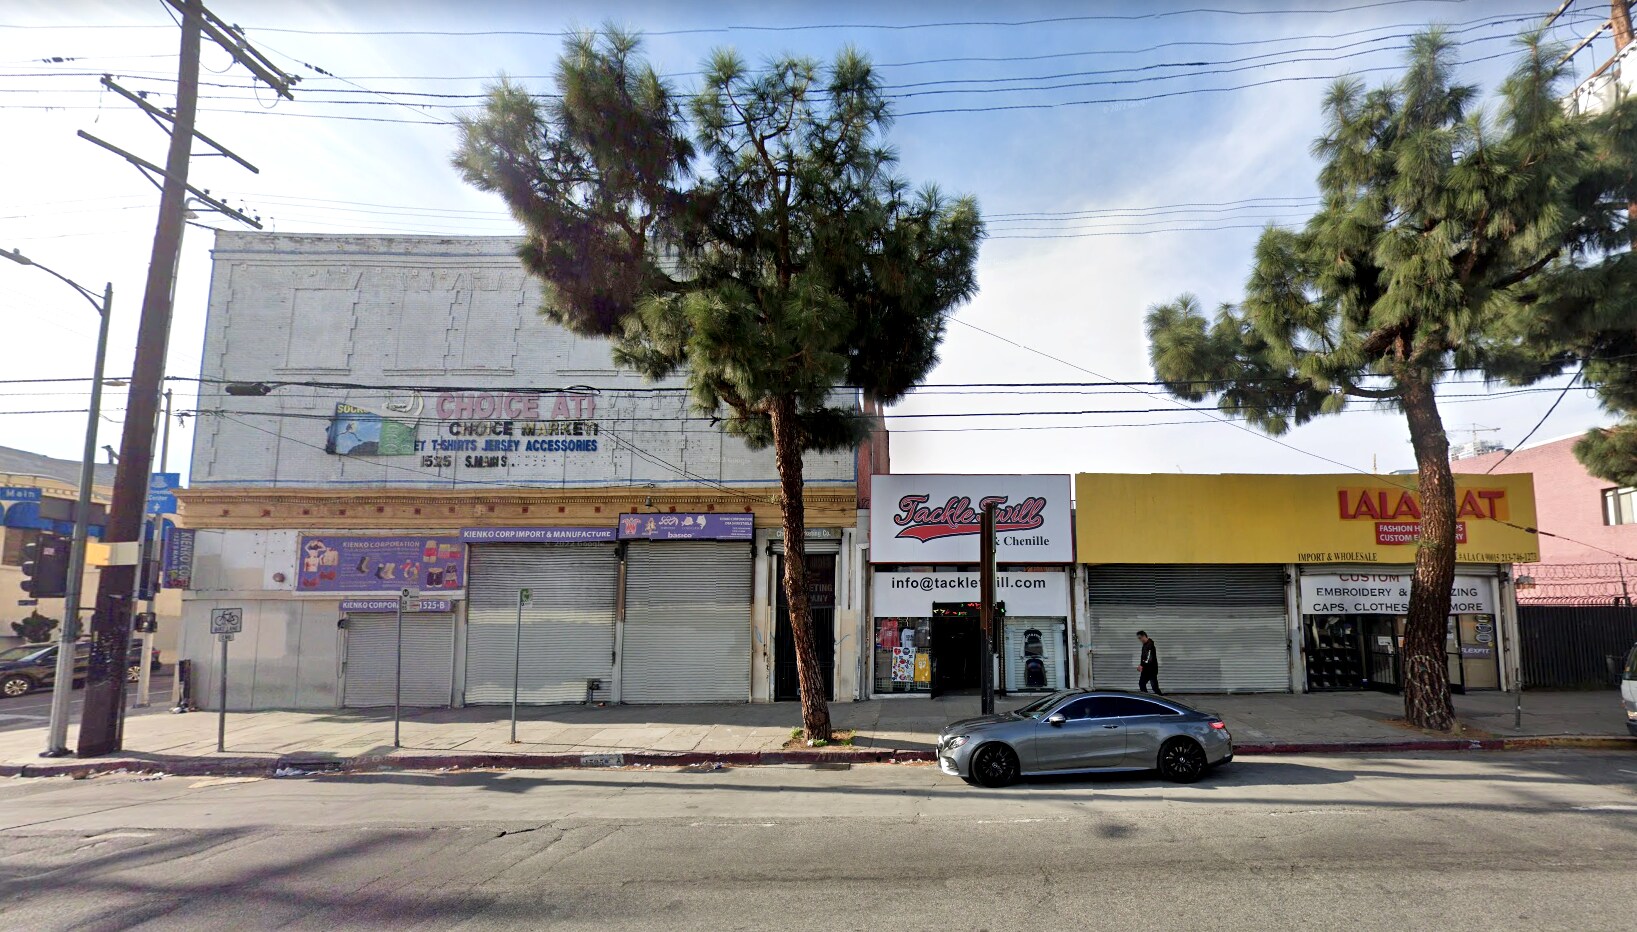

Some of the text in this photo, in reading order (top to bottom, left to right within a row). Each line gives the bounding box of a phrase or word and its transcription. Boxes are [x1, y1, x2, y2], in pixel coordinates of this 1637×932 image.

[436, 392, 540, 420] CHOICE
[449, 421, 513, 436] CHOICE
[414, 439, 598, 451] ET T-SHIRTS JERSEY ACCESSORIES
[6, 489, 36, 498] Main
[893, 493, 976, 529] Tackle
[463, 530, 611, 538] KIENKO CORP IMPORT & MANUFACTURE
[1379, 525, 1413, 533] FASHION
[1003, 535, 1050, 546] Chenille
[1379, 534, 1412, 542] CUSTOM
[342, 541, 420, 549] KIENKO CORPORATION
[1298, 552, 1378, 562] IMPORT & WHOLESALE
[1339, 574, 1400, 582] CUSTOM
[891, 576, 1046, 591] info@tackleill.com
[1316, 587, 1392, 597] EMBROIDERY
[1398, 588, 1408, 597] &
[342, 601, 368, 609] KIENKO
[368, 601, 399, 609] CORPORA
[1312, 603, 1348, 613] CAPS,
[1450, 602, 1483, 612] MORE
